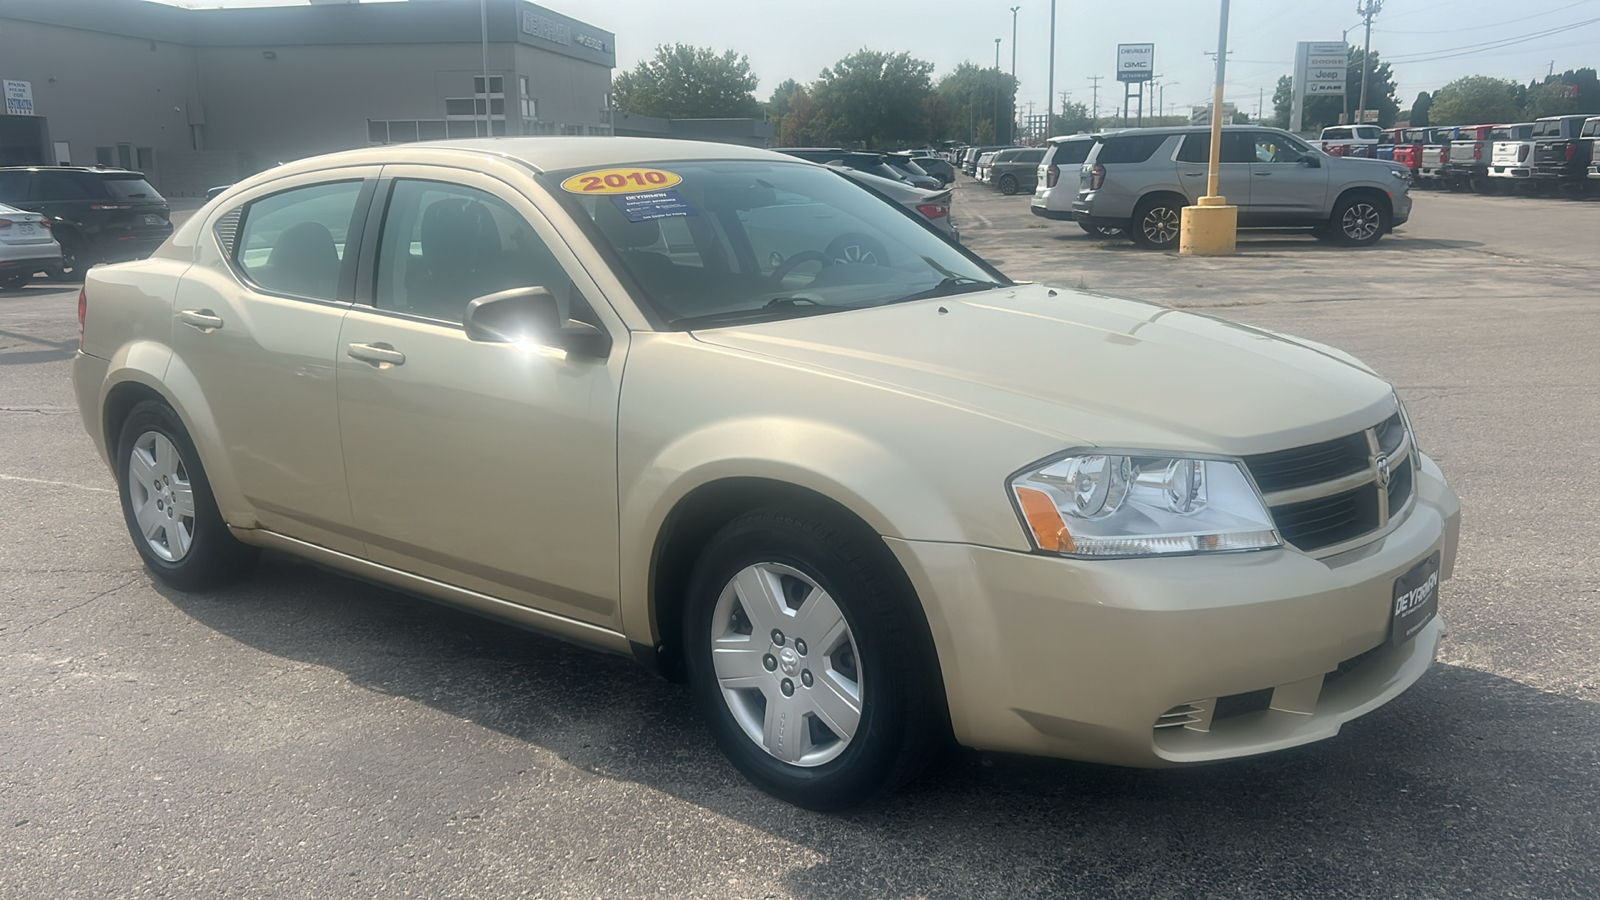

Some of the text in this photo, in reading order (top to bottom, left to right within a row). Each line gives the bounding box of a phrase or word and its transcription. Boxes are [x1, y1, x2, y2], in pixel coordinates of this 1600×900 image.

[1315, 70, 1338, 79] Jeep
[579, 171, 668, 191] 2010
[1395, 569, 1439, 617] DEYARMAN
